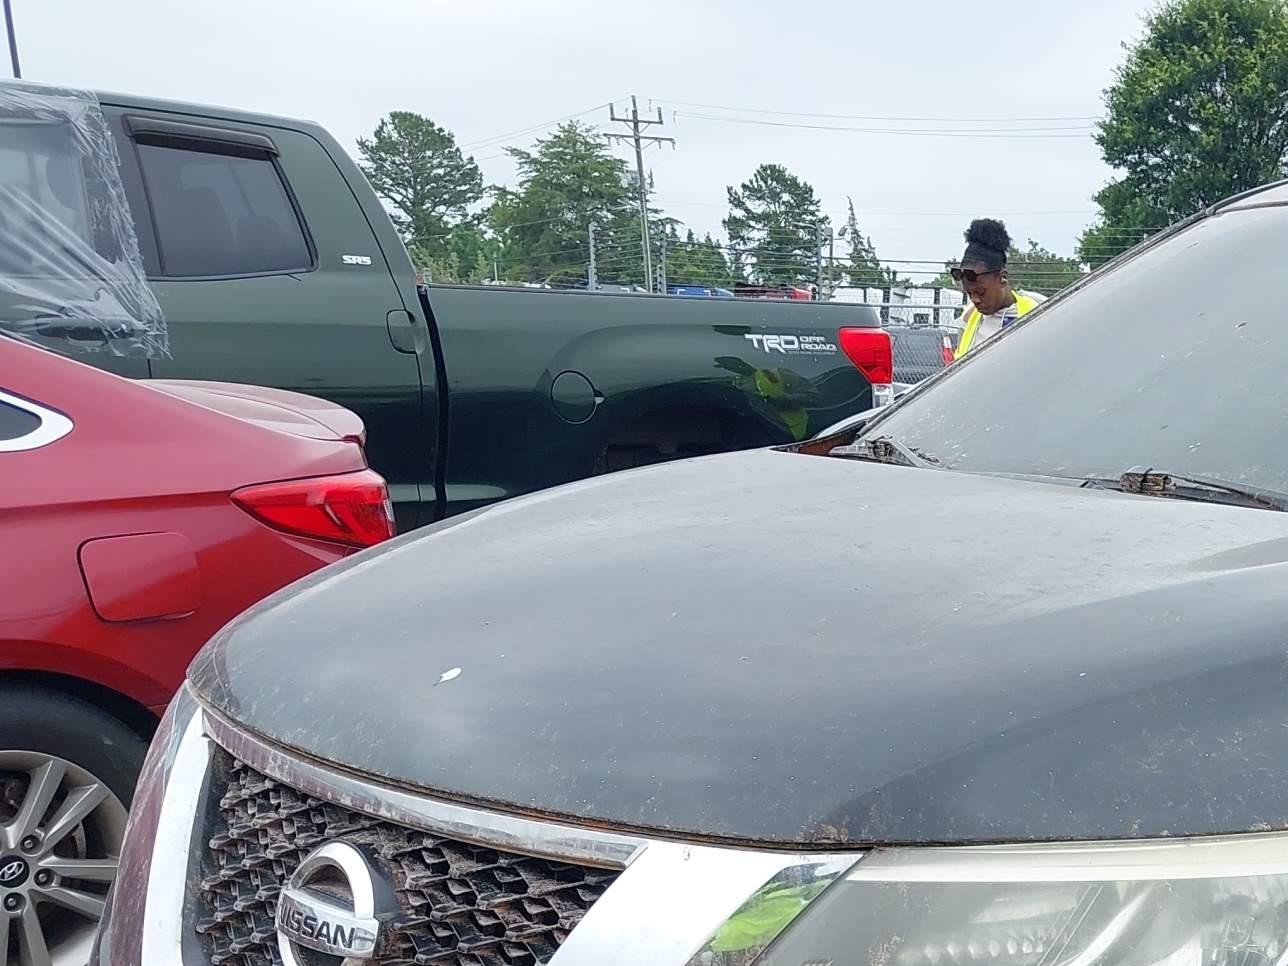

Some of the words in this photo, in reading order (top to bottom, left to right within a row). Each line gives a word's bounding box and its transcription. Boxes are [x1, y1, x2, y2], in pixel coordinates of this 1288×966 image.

[744, 333, 799, 353] TRD
[800, 343, 838, 351] ROAD
[278, 902, 356, 949] NISSAN
